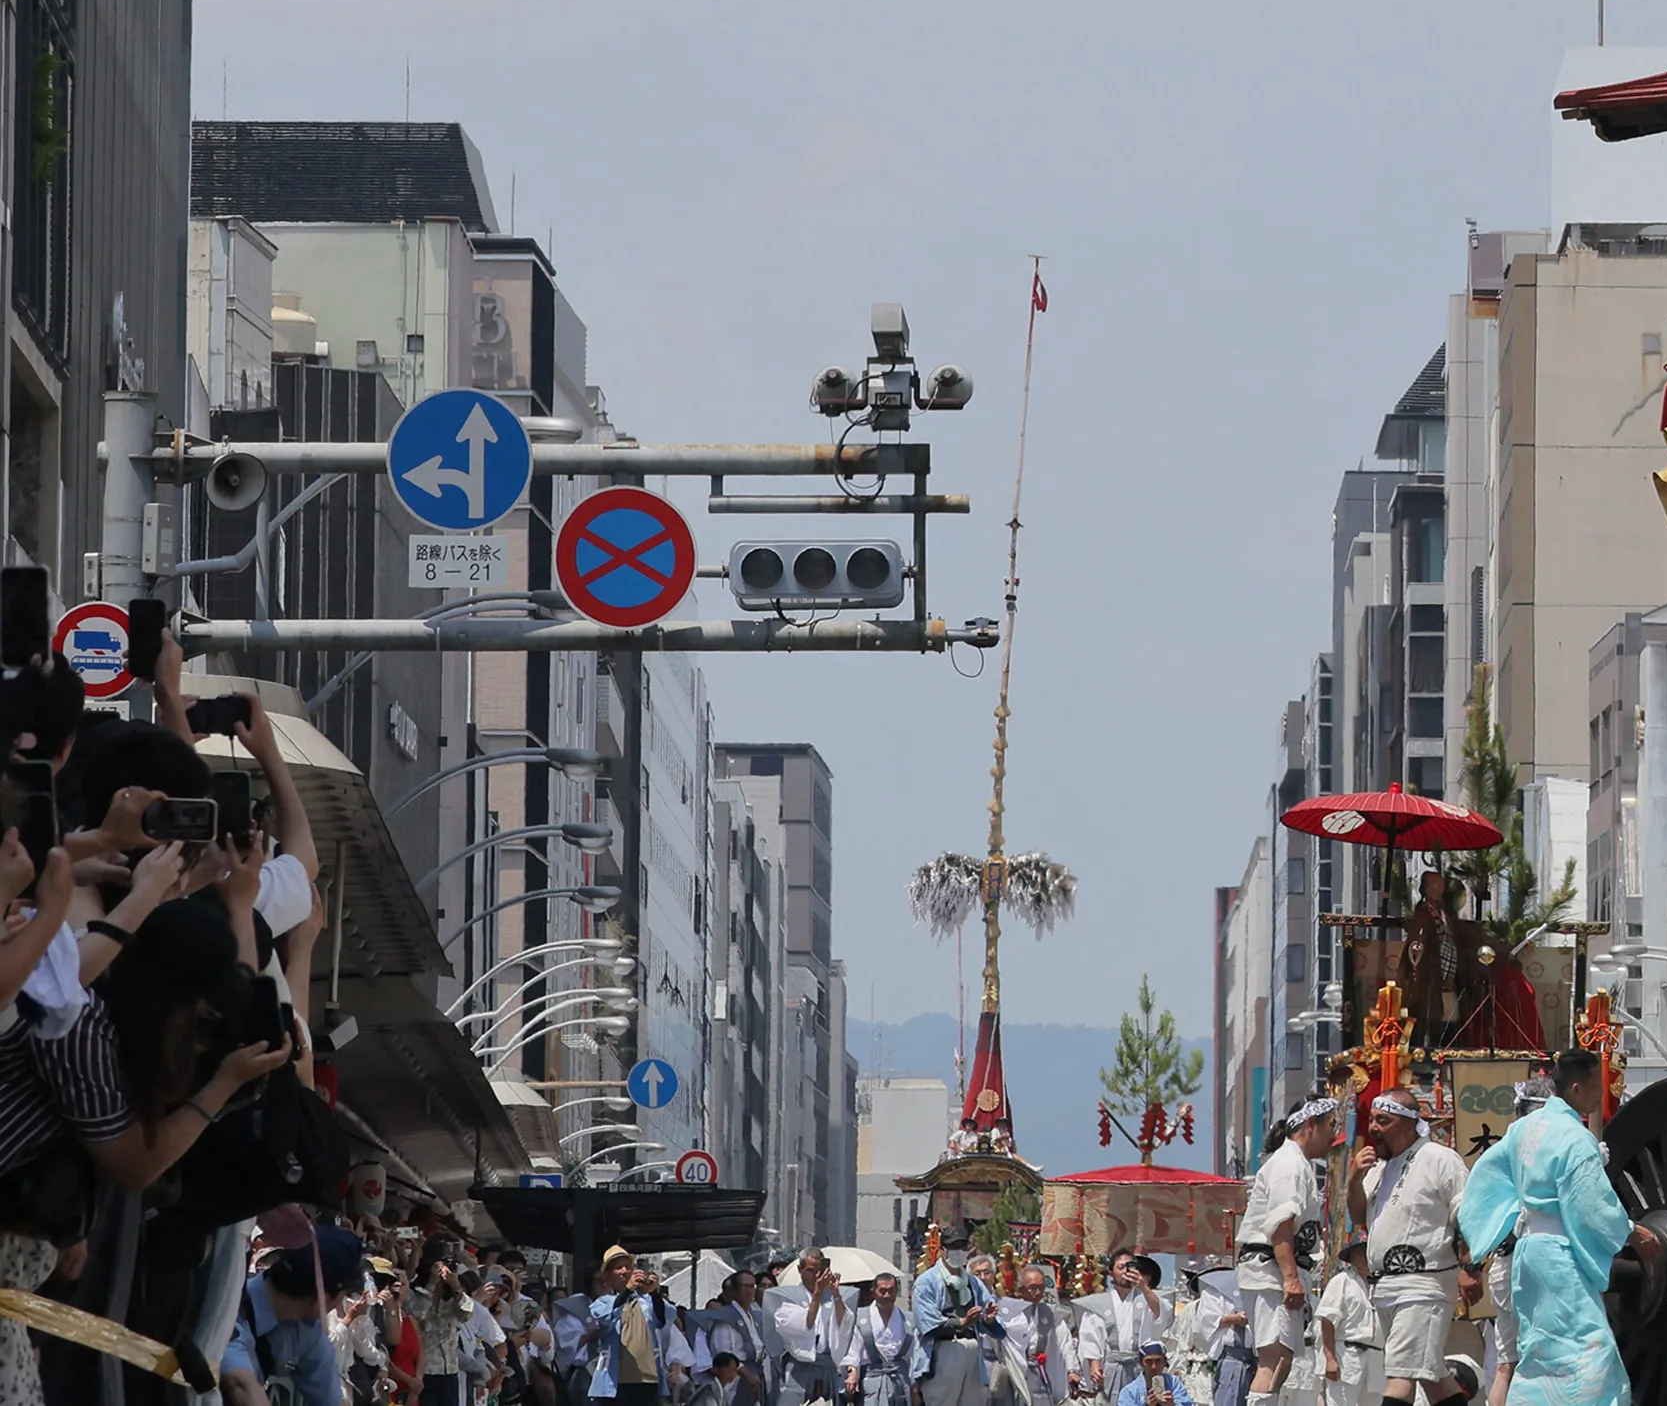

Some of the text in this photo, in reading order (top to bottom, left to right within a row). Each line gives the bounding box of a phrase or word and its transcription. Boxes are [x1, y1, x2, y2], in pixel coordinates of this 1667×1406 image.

[415, 543, 502, 562] 路線バスを除く
[685, 1162, 708, 1182] 40
